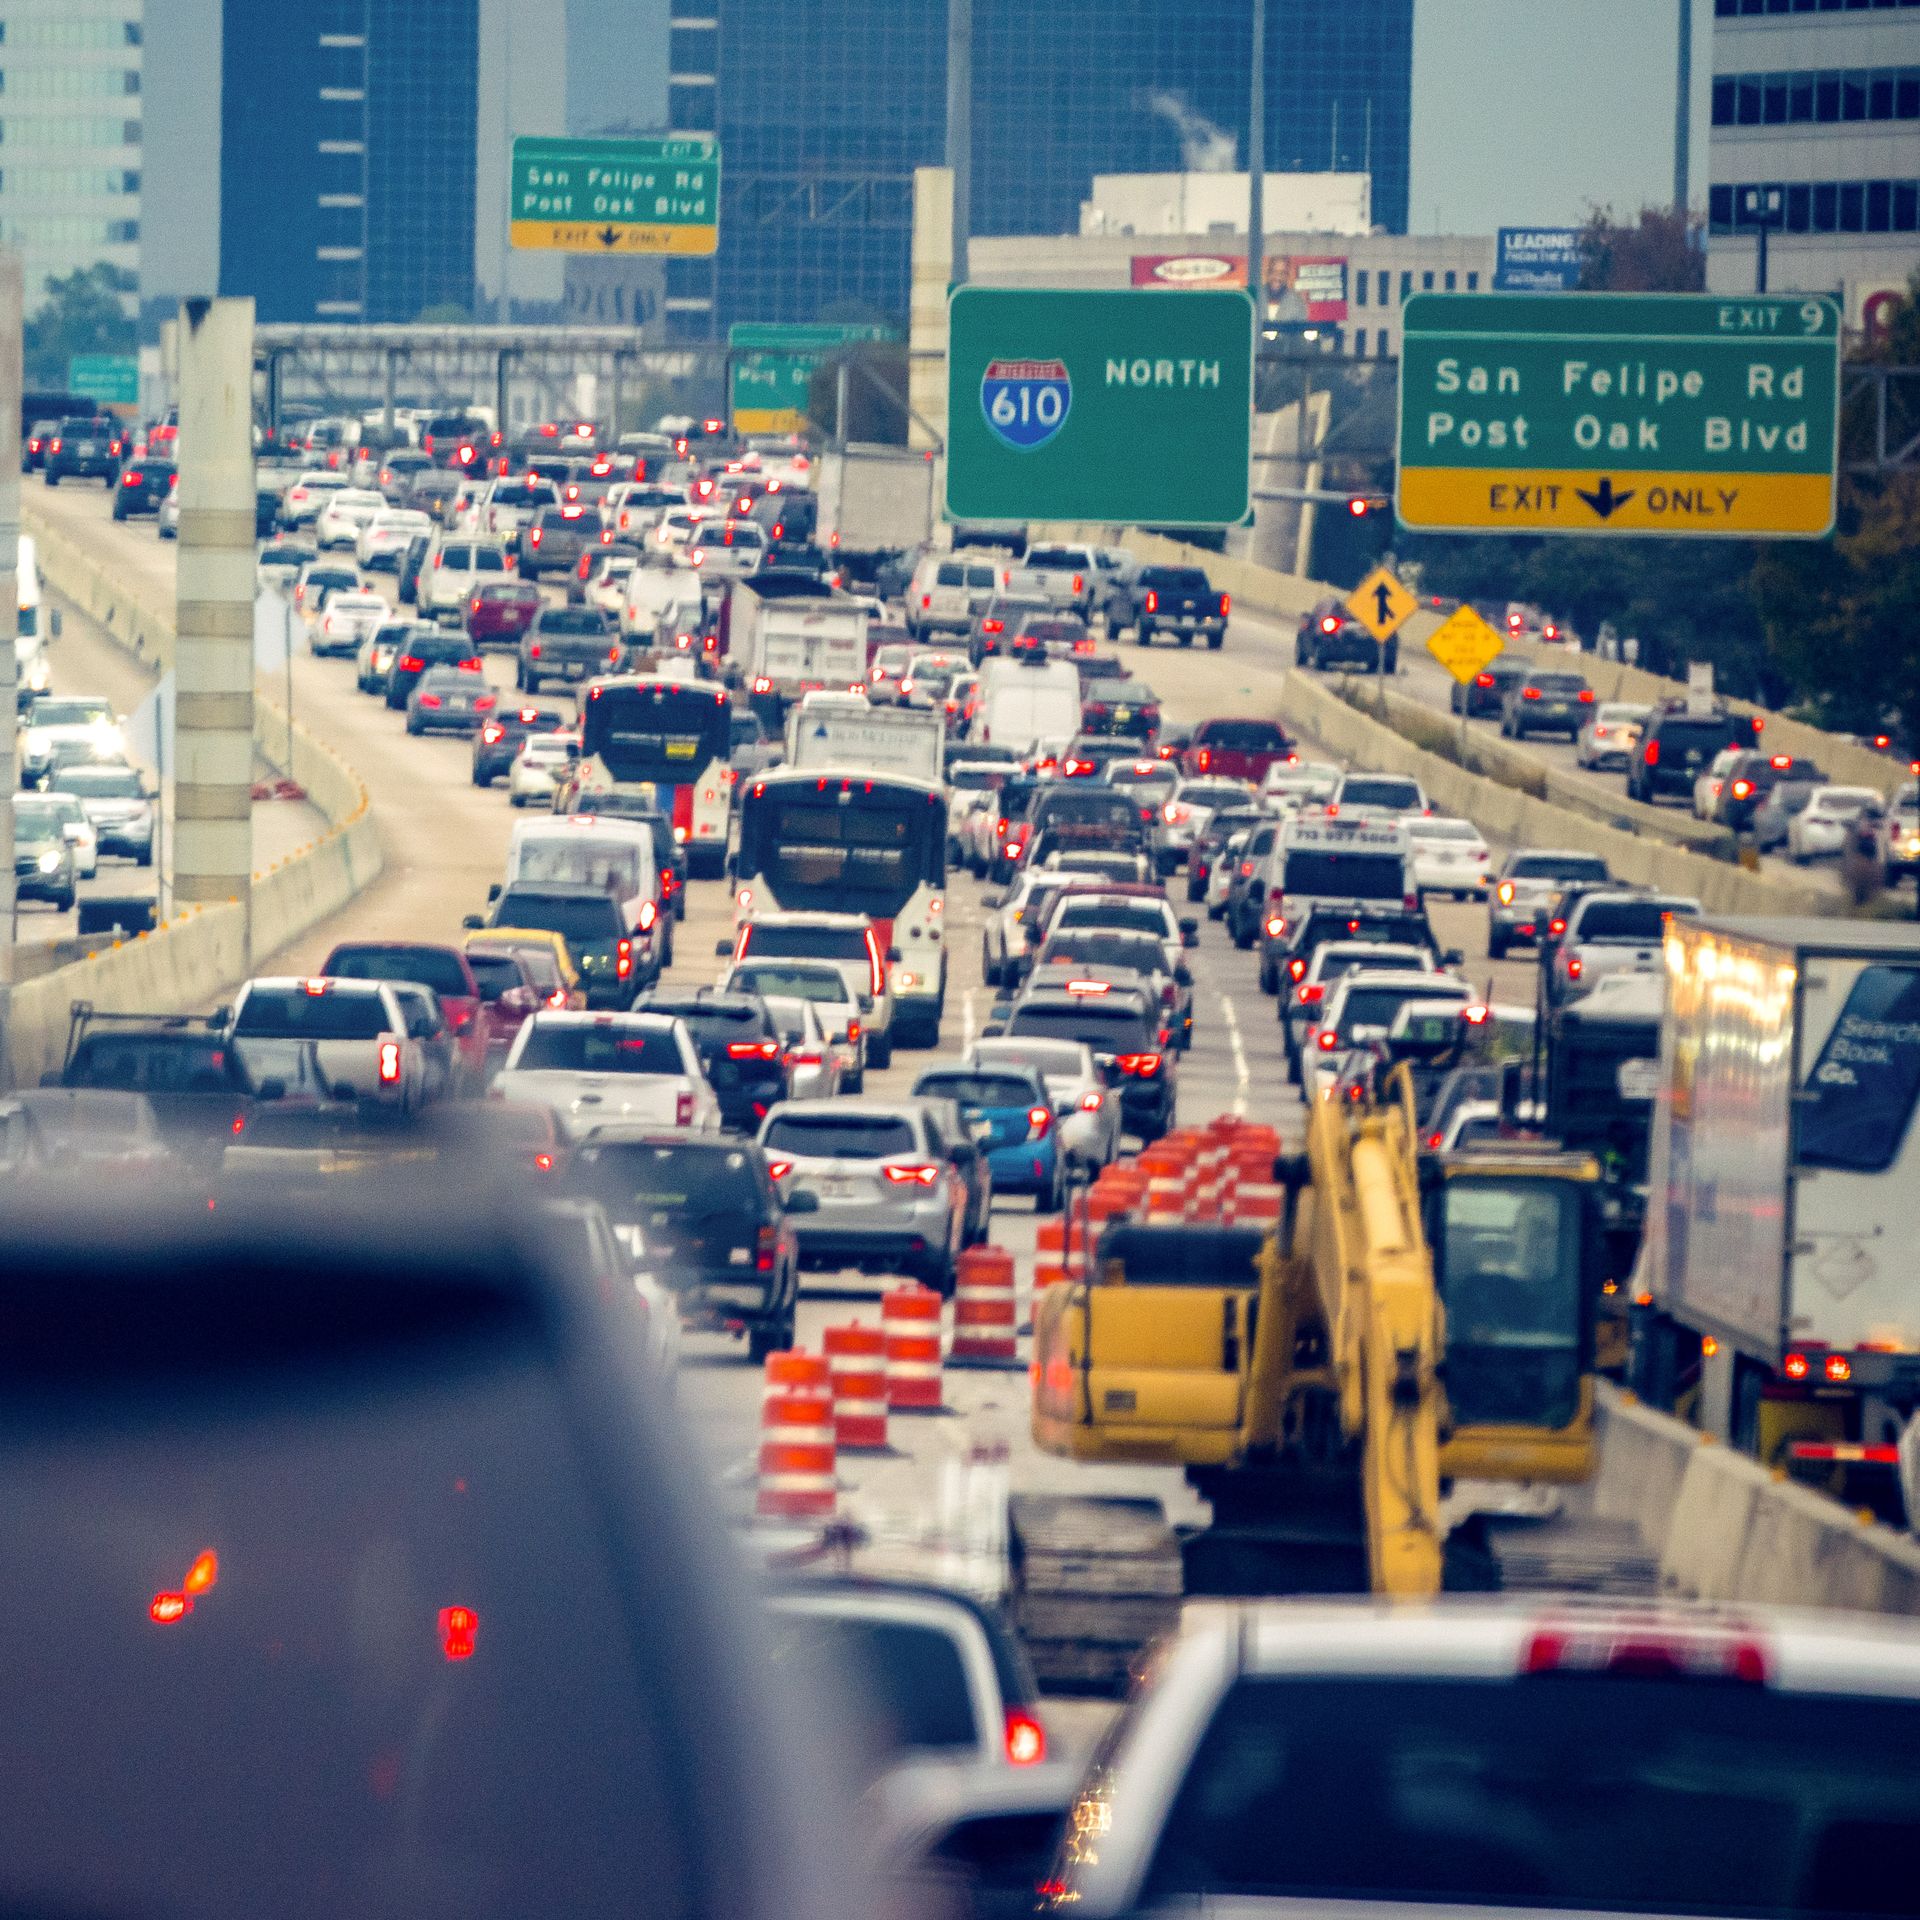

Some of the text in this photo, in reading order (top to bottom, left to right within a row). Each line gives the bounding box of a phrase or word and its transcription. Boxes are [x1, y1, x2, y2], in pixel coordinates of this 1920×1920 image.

[527, 166, 704, 191] San Felipe Rd
[523, 193, 705, 216] Post Oak Blvd
[553, 228, 671, 244] EXIT ONLY
[1719, 301, 1825, 334] EXIT 9
[1106, 358, 1220, 387] NORTH
[1436, 358, 1804, 403] San Felipe Rd
[991, 386, 1062, 427] 610
[1428, 413, 1808, 452] Post Oak Blvd
[1489, 483, 1739, 514] EXIT ONLY
[1830, 1039, 1889, 1063] Book
[1817, 1062, 1858, 1085] Go.
